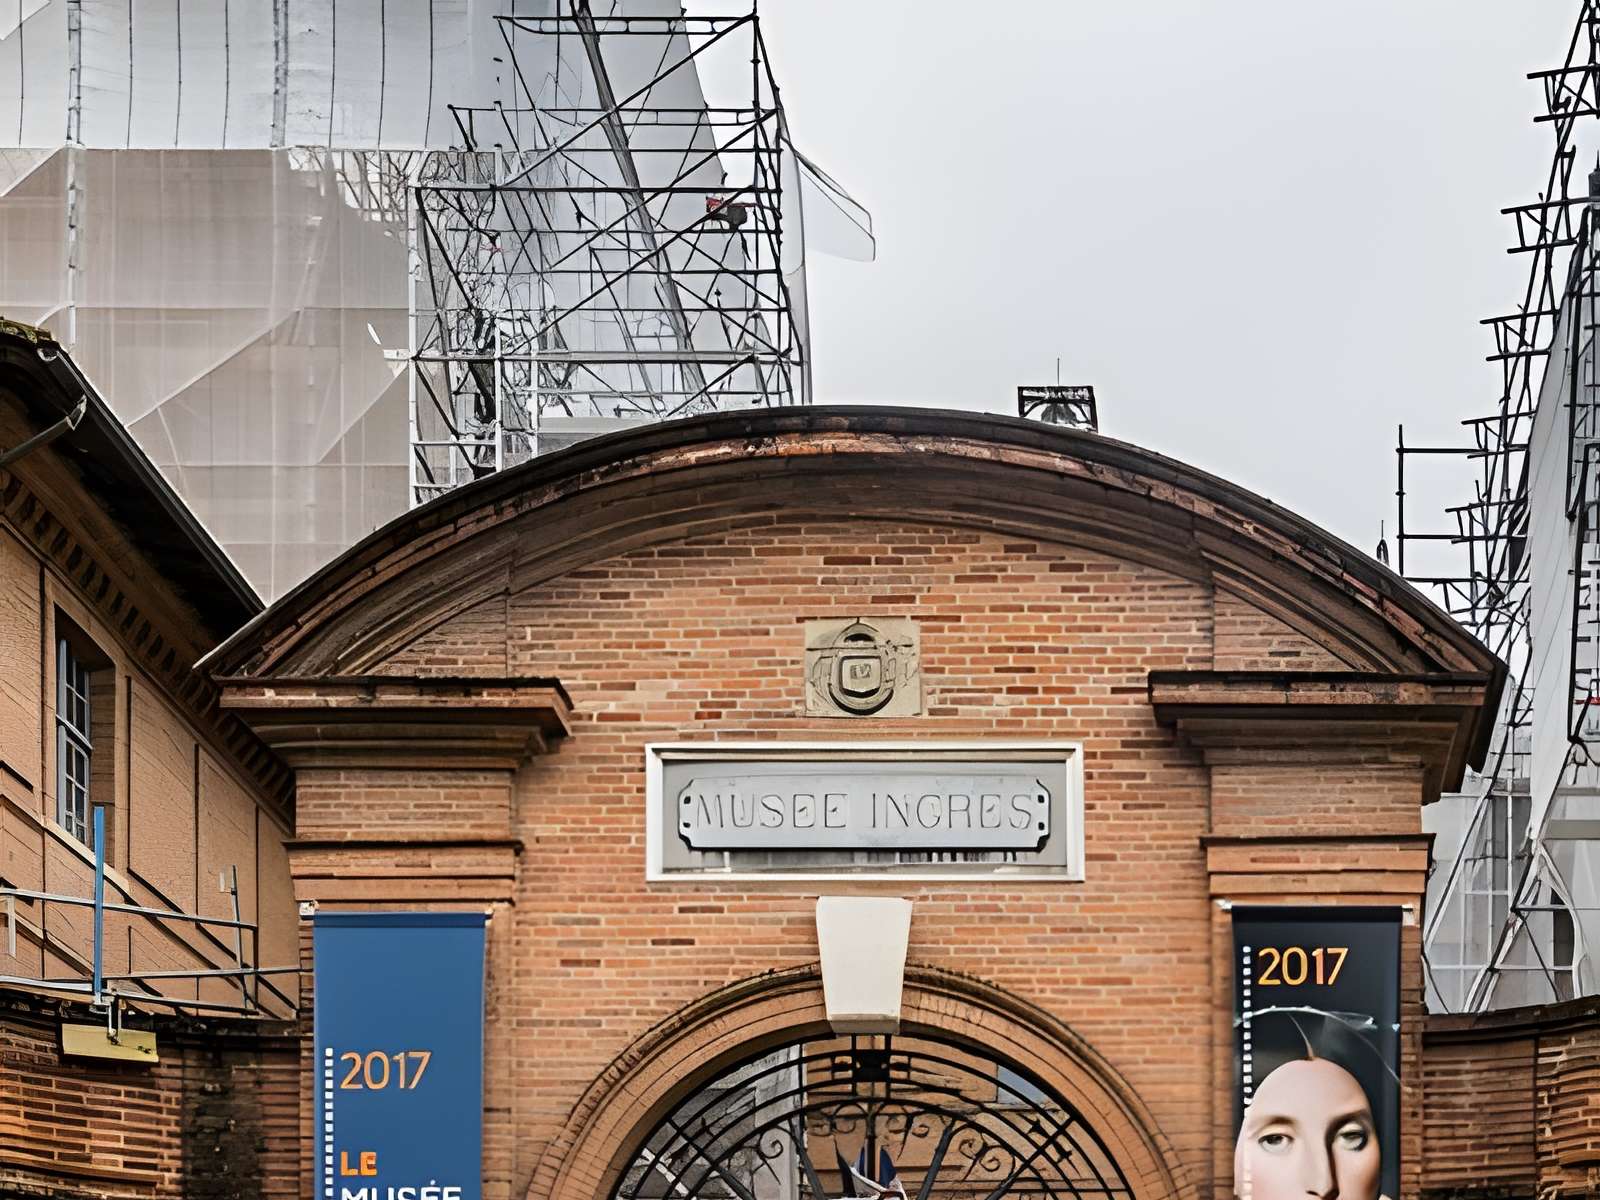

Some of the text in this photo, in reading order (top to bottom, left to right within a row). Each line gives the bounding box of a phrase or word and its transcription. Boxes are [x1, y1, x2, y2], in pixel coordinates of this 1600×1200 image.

[871, 793, 1032, 829] INGRES
[1256, 945, 1349, 987] 2017
[340, 1051, 431, 1090] 2017
[340, 1151, 378, 1176] LE
